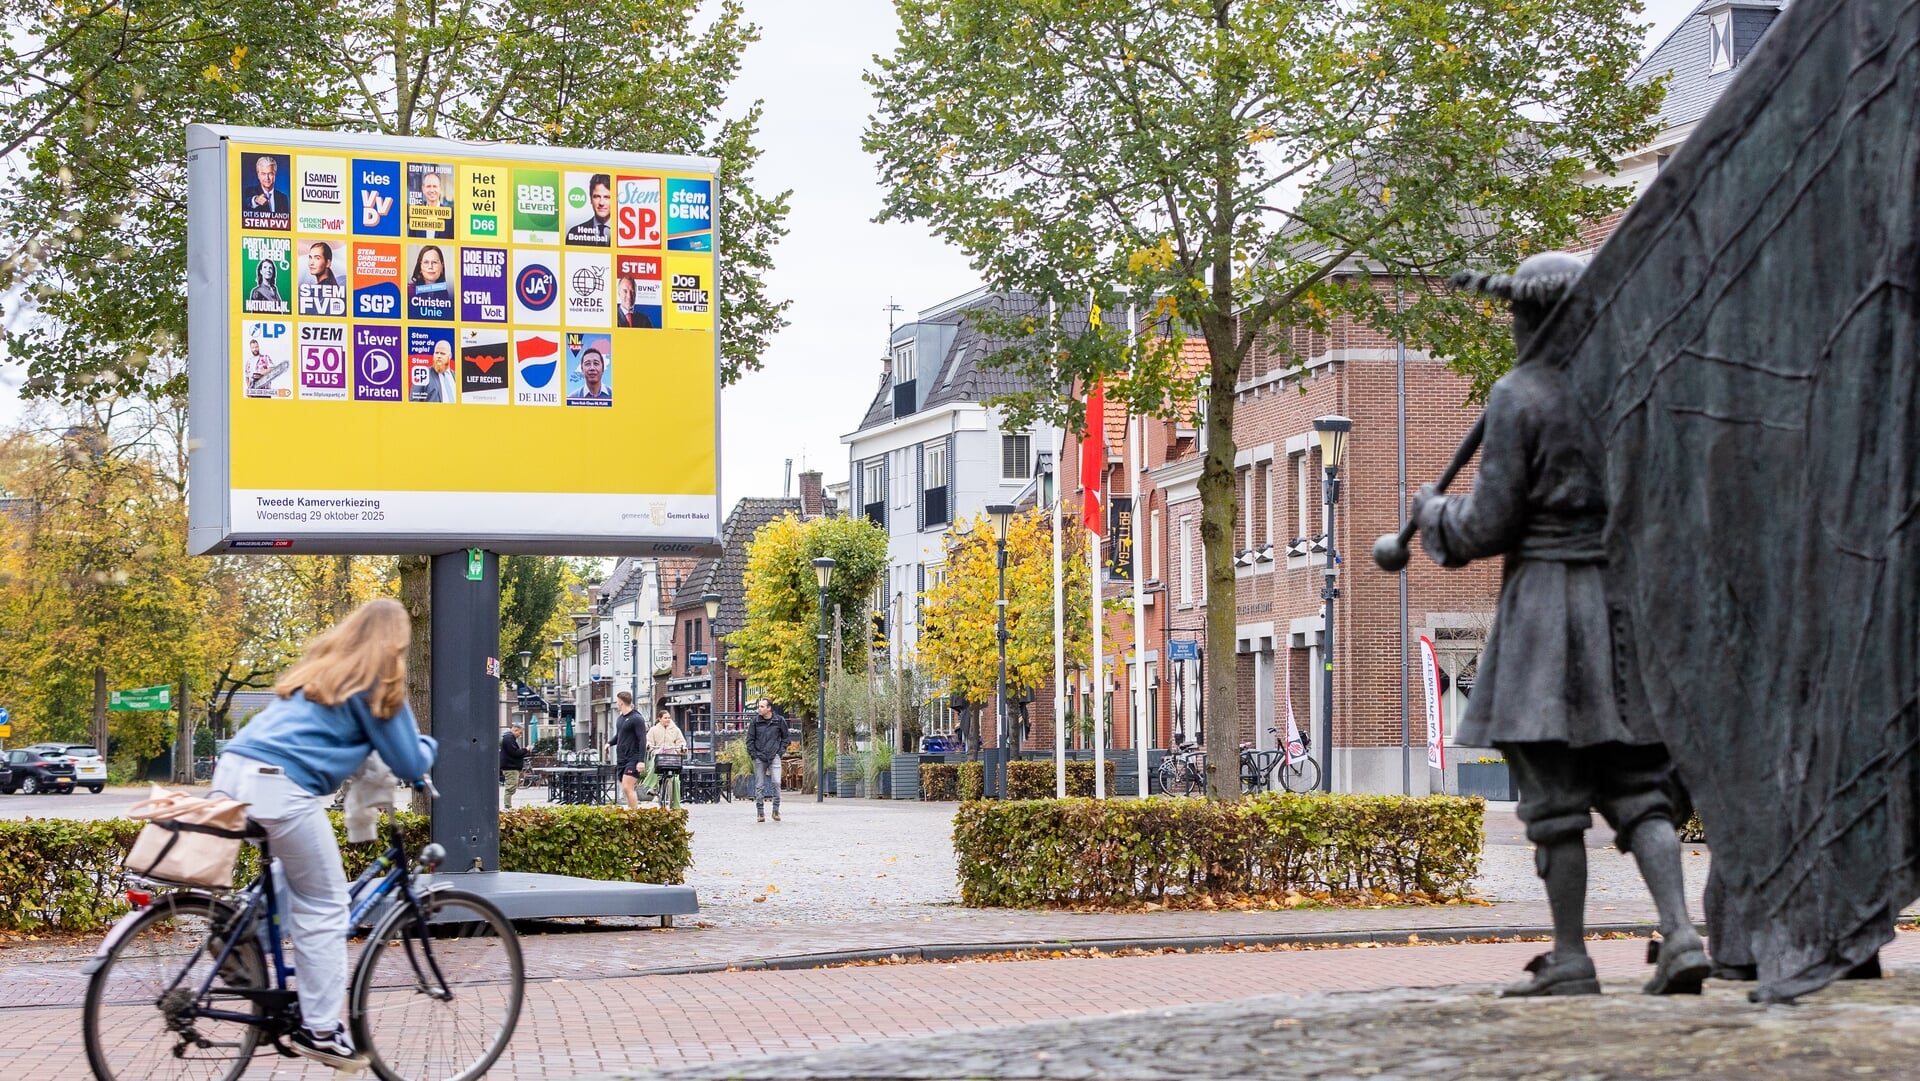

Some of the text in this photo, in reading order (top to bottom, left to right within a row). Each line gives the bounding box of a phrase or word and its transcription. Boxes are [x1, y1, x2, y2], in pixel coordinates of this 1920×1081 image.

[409, 164, 422, 173] EDDY
[423, 165, 435, 174] VAN
[308, 173, 337, 184] SAMEN
[363, 171, 390, 185] kies
[472, 172, 496, 185] Het
[305, 189, 340, 200] VOORUIT
[472, 186, 496, 198] kan
[517, 184, 555, 201] BBB
[618, 181, 659, 205] Stem
[671, 189, 706, 204] stem
[411, 207, 450, 217] ZORGEN VOOR
[472, 199, 496, 212] wél
[669, 203, 710, 220] DENK
[245, 218, 288, 229] STEM PVV
[321, 219, 341, 230] PvdA
[472, 218, 495, 231] D66
[577, 226, 598, 234] Henri
[243, 237, 290, 251] PARTIJ VOOR
[248, 249, 259, 260] DE
[463, 250, 505, 265] DOE IETS
[463, 263, 502, 278] NIEUWS
[622, 262, 657, 275] STEM
[672, 275, 696, 288] Doe
[299, 284, 345, 298] STEM
[638, 284, 656, 293] BVNL
[360, 294, 395, 313] SGP
[411, 297, 451, 307] Christen
[463, 291, 491, 305] STEM
[569, 298, 603, 308] VREDE
[299, 297, 345, 315] FVD
[420, 307, 443, 317] Unie
[484, 307, 502, 317] Volt
[262, 323, 286, 339] LP
[301, 327, 343, 341] STEM
[357, 329, 398, 346] Liever
[569, 334, 582, 345] NL
[305, 348, 340, 372] 50
[306, 374, 339, 385] PLUS
[466, 375, 479, 383] LIEF
[358, 385, 399, 398] Piraten
[519, 392, 557, 402] DE LINIE
[256, 497, 380, 509] Tweede Kamerverkiezing
[256, 510, 385, 522] Woensdag 29 oktober 2025
[1118, 511, 1131, 567] BOTTEGA
